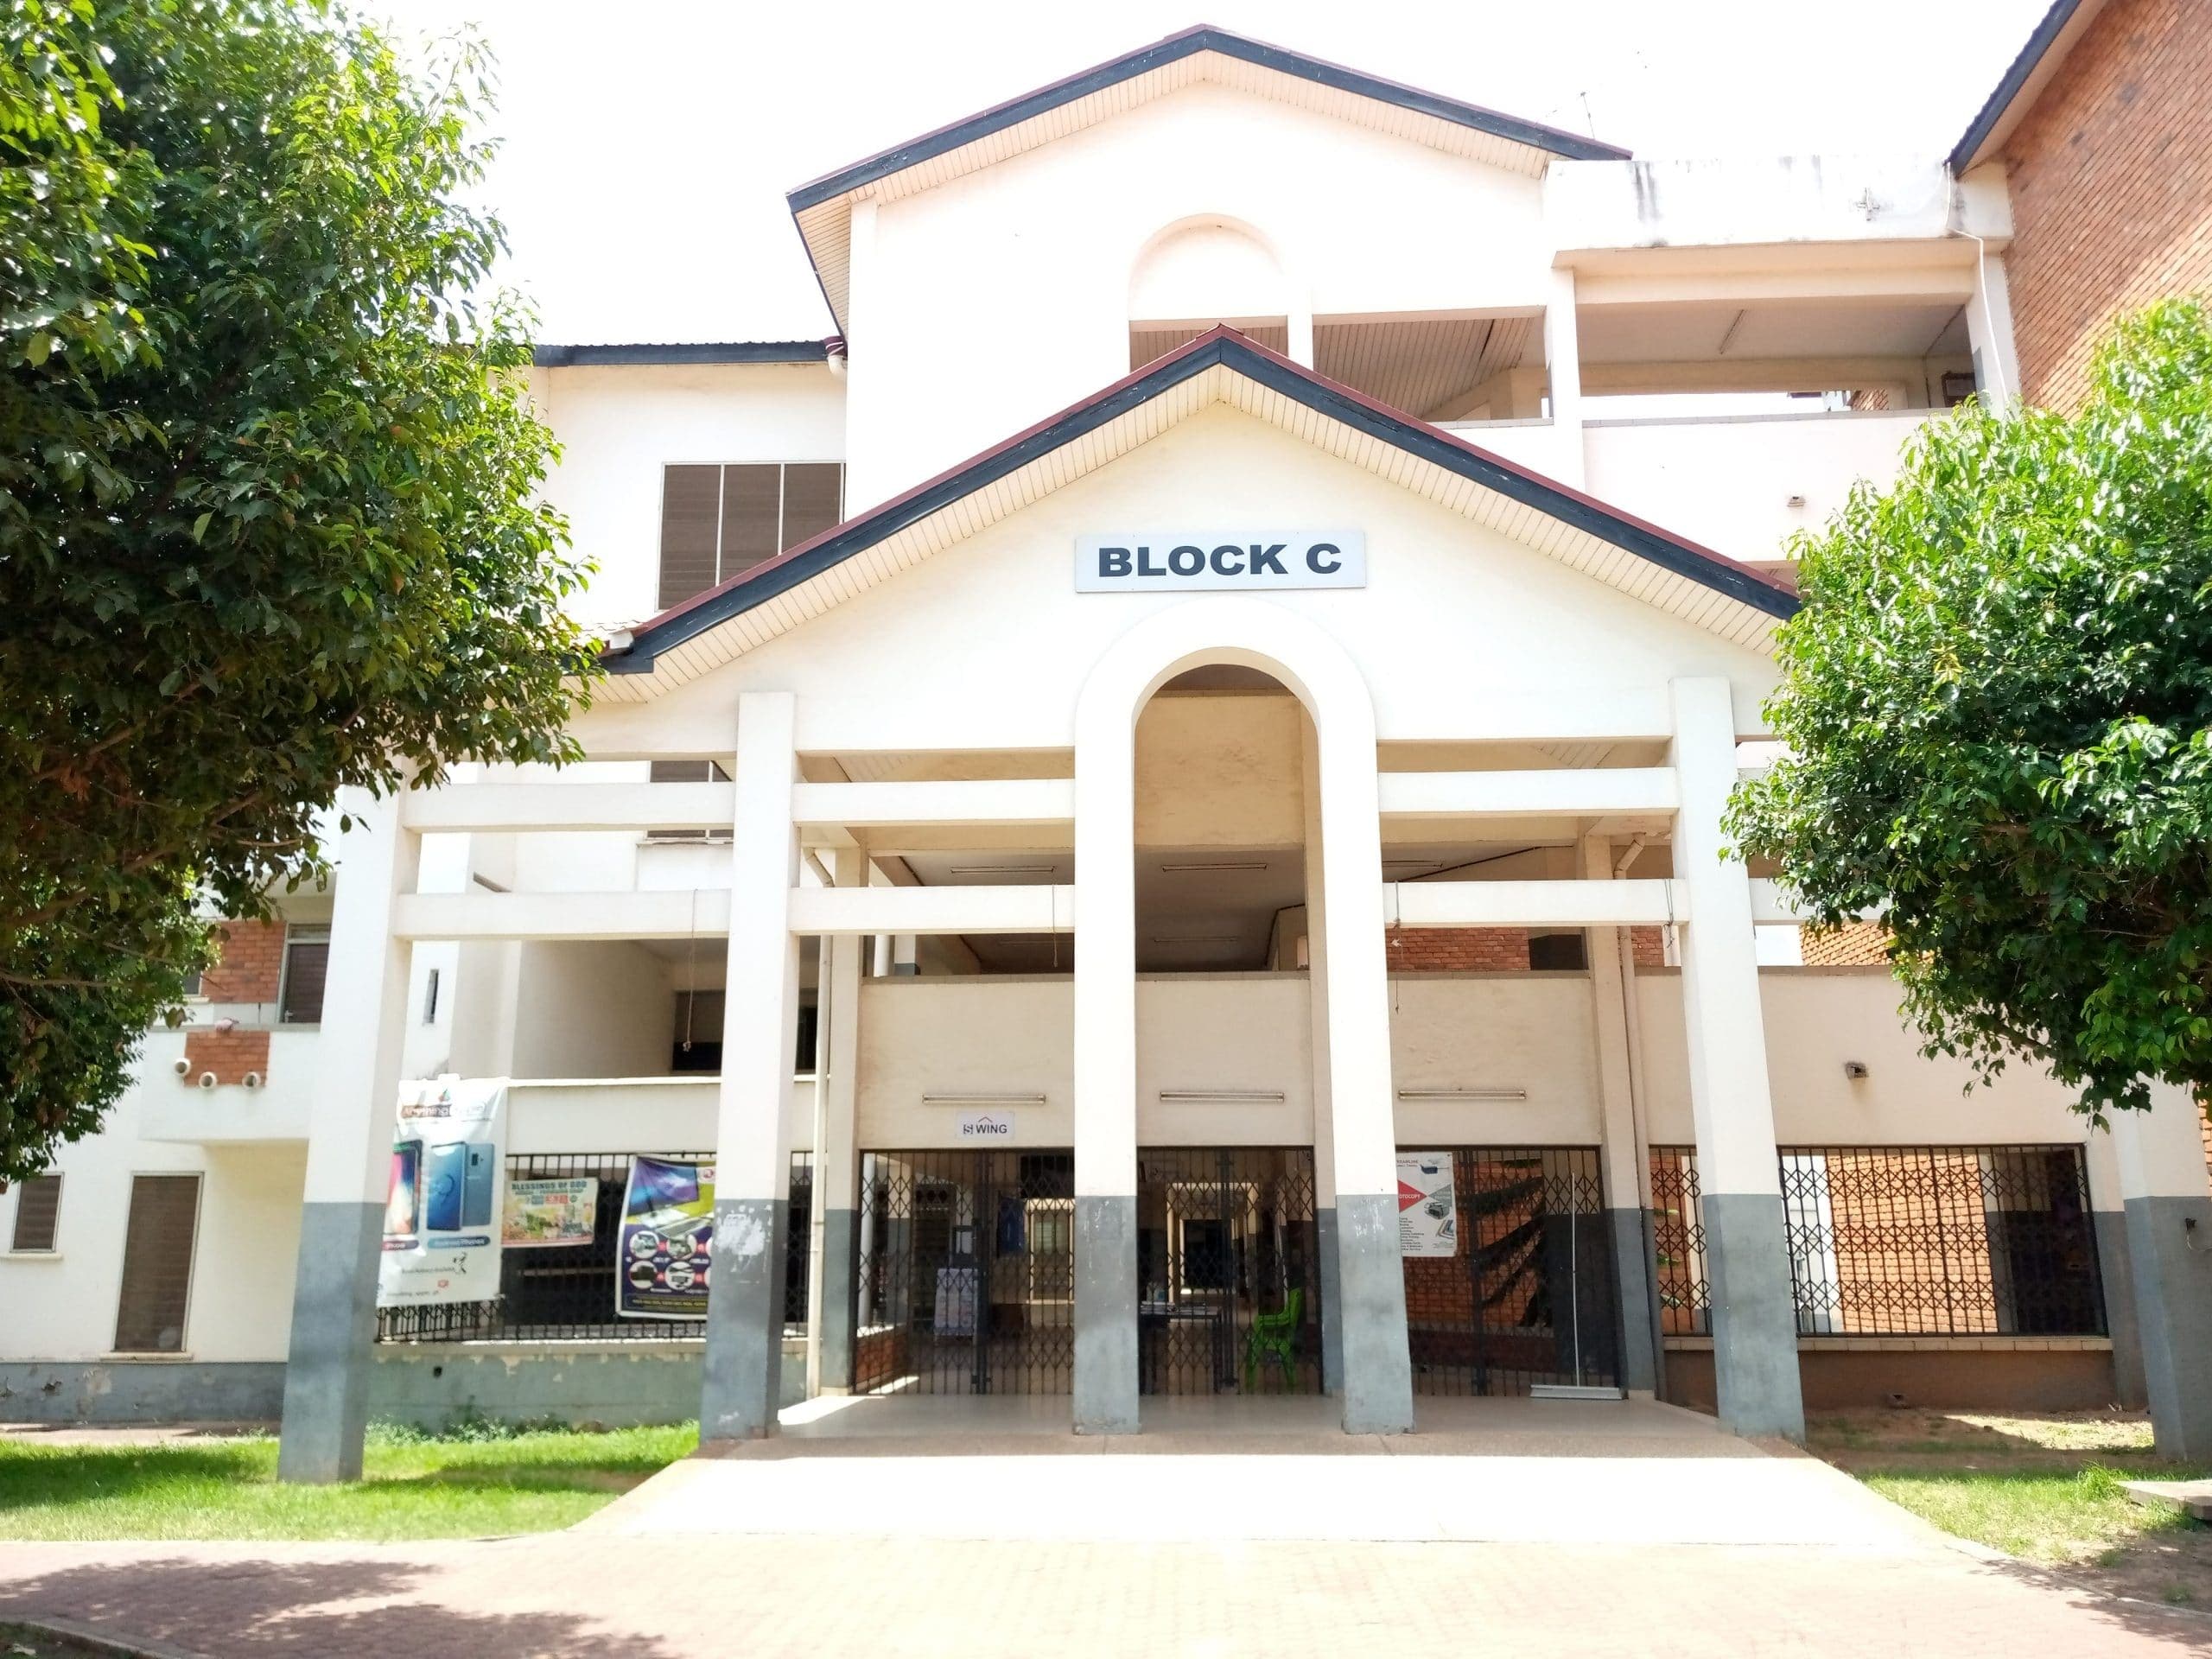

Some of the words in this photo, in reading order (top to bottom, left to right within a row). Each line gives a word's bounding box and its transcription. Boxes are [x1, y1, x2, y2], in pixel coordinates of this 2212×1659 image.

[1098, 543, 1288, 577] BLOCK
[1306, 543, 1342, 575] C
[976, 1123, 1007, 1135] WING
